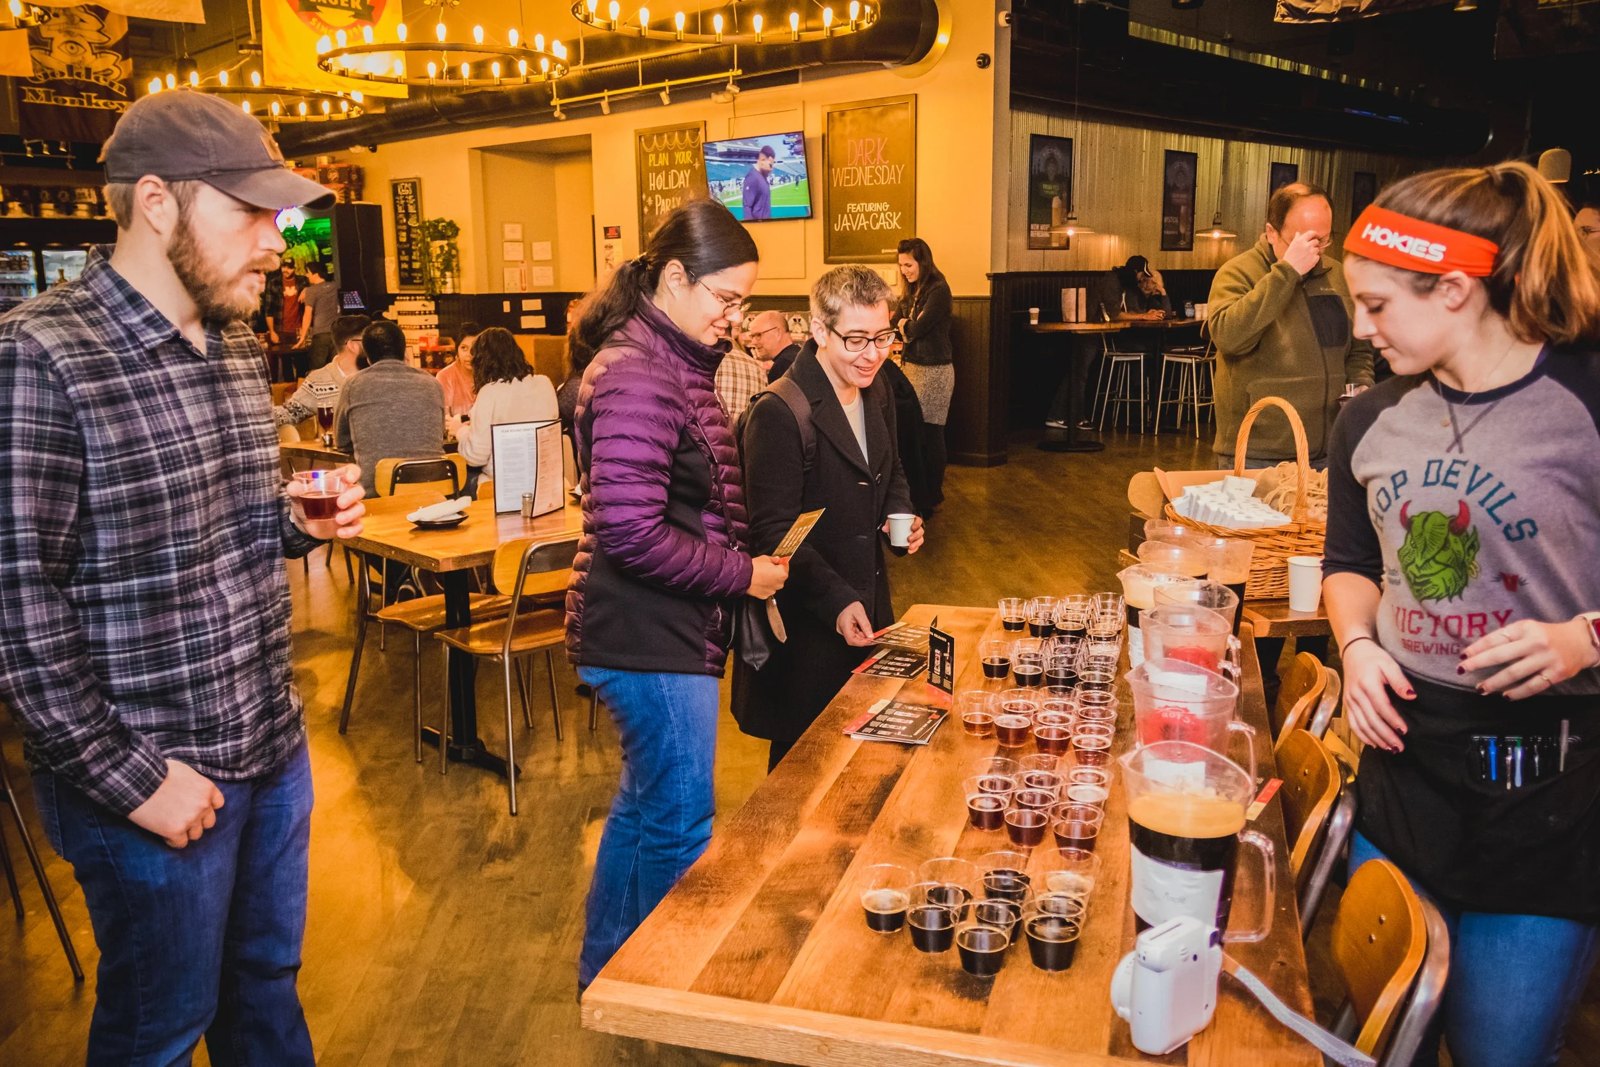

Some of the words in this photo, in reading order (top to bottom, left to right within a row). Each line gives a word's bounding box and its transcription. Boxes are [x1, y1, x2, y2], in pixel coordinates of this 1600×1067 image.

[20, 86, 133, 113] Monkey
[648, 152, 669, 167] PLAN
[674, 150, 693, 165] YOUR
[847, 137, 889, 167] DARK
[832, 164, 905, 187] WEDNESDAY
[846, 201, 890, 213] FEATURING
[1361, 222, 1447, 262] HOKIES
[1422, 459, 1539, 543] DEVILS
